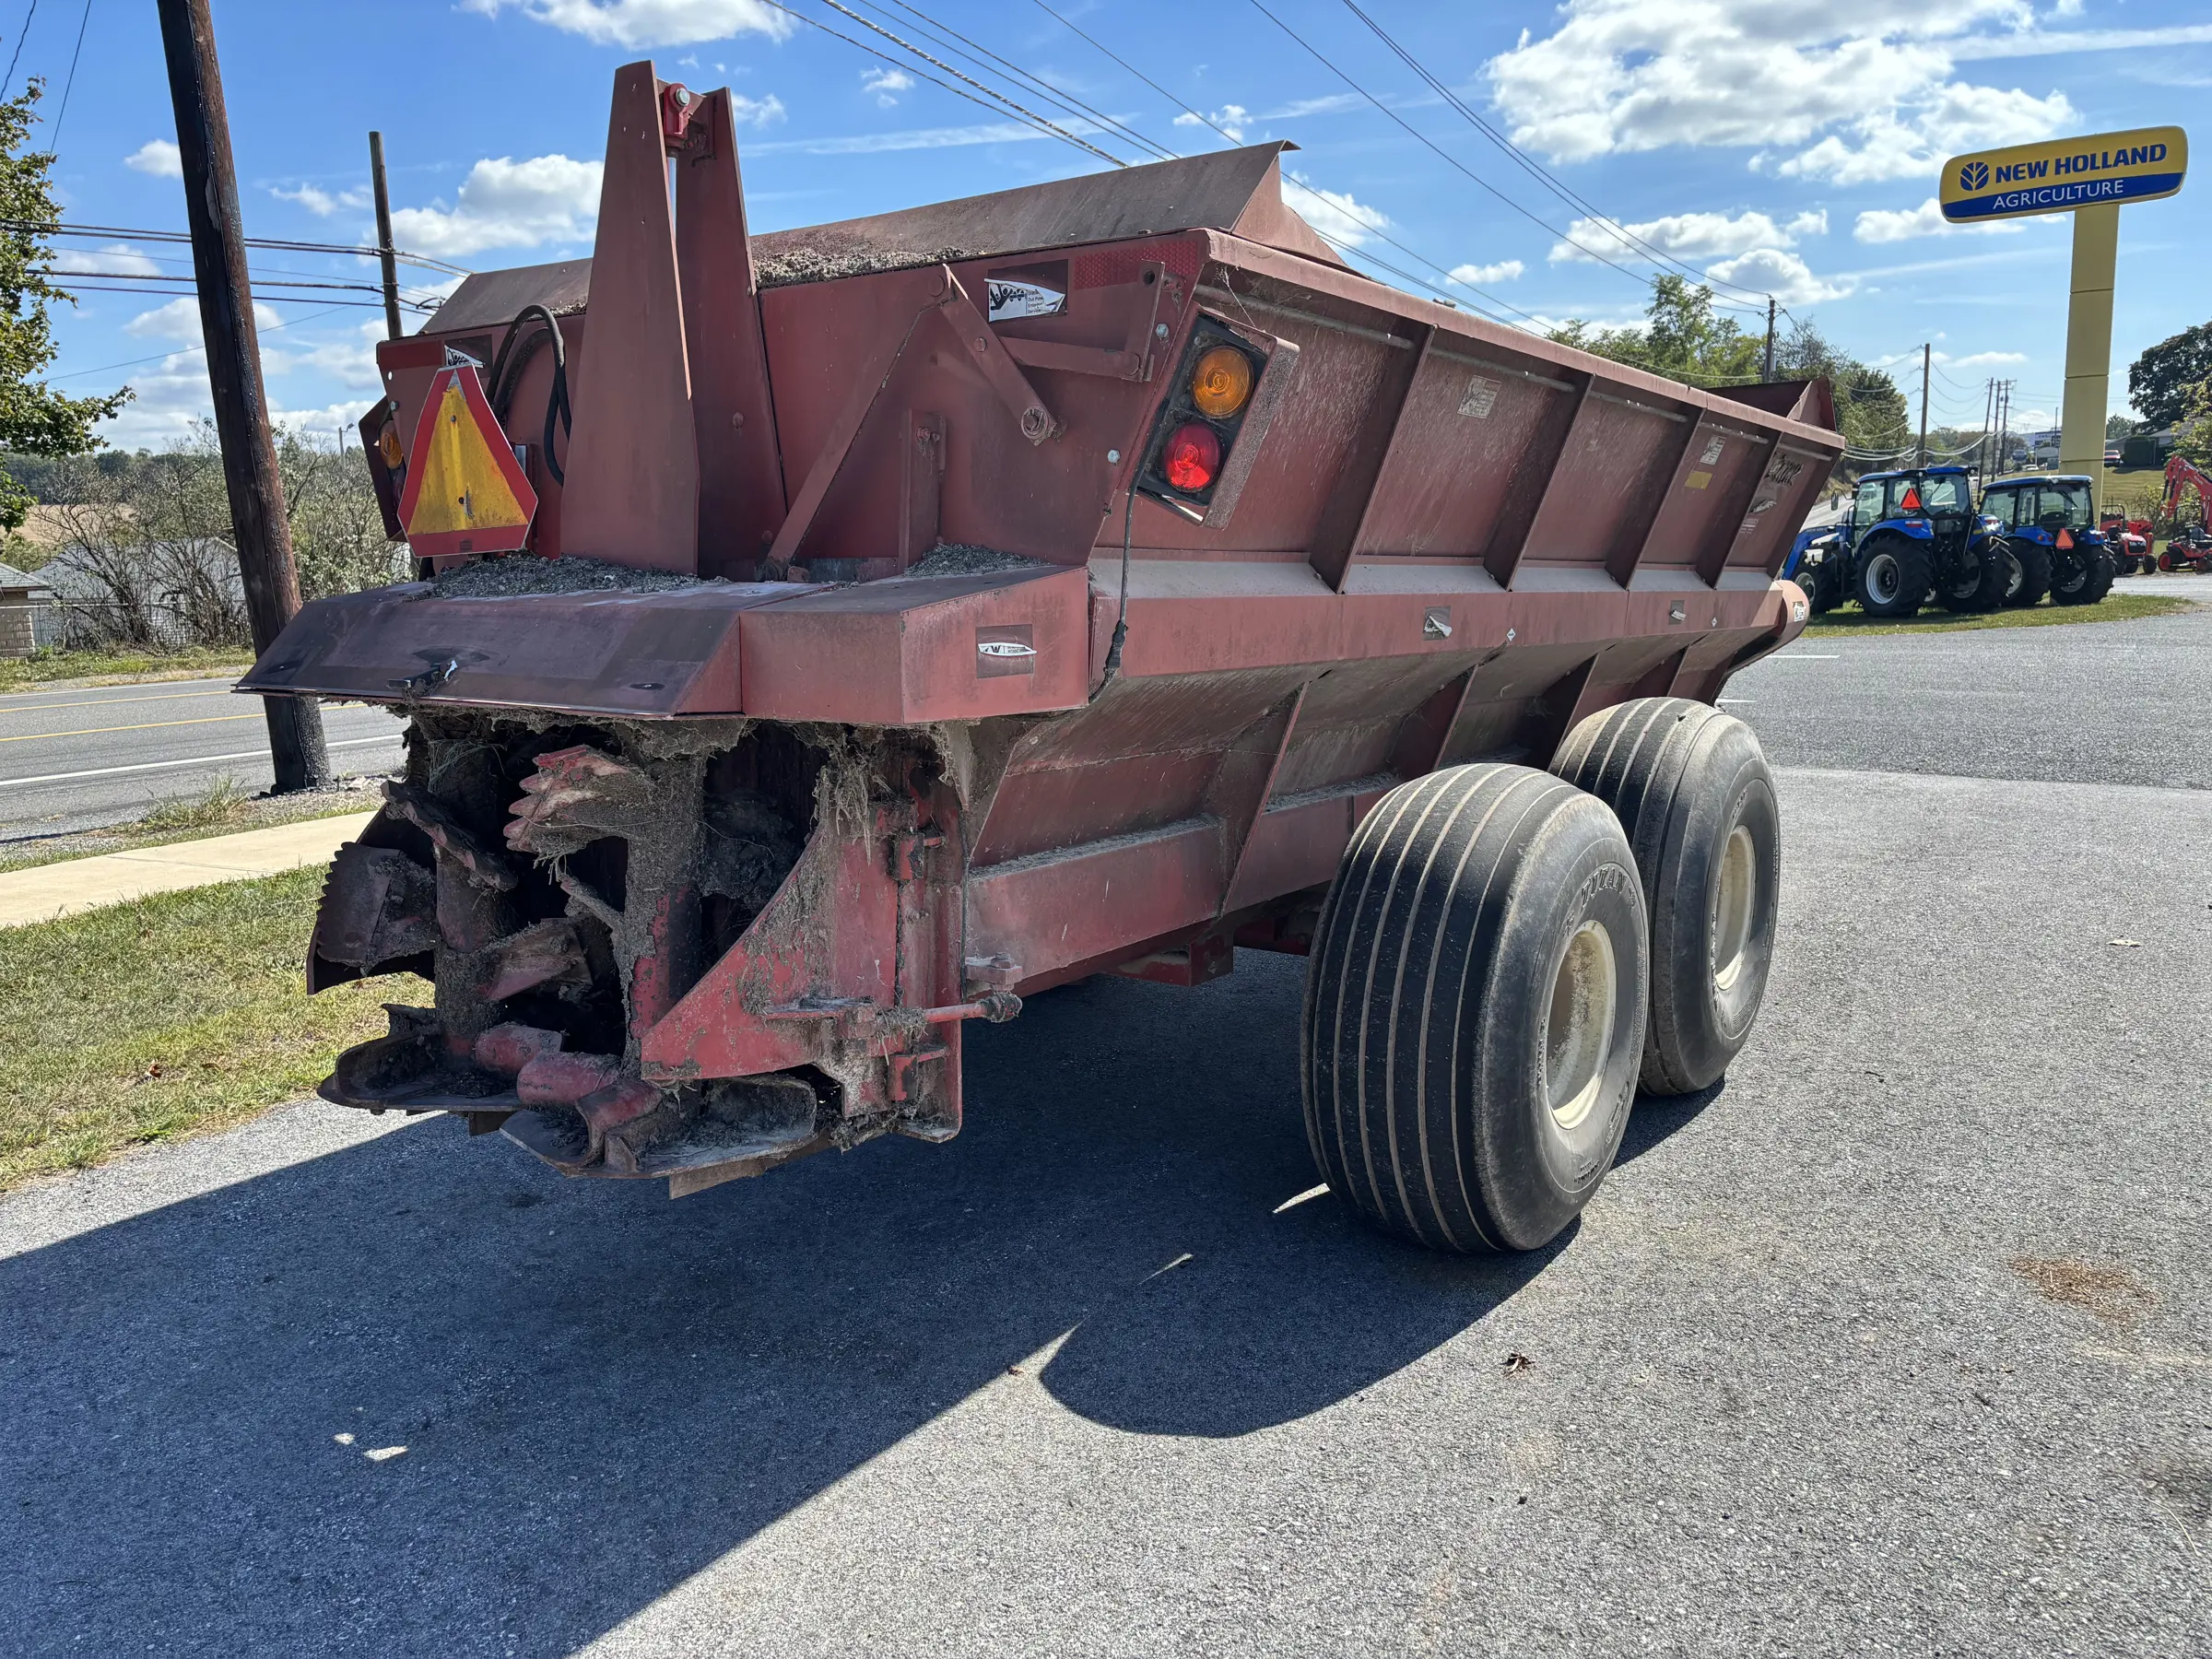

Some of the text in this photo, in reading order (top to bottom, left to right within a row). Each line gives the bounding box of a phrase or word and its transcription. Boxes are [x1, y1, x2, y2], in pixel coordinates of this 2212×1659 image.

[1995, 144, 2167, 183] NEW HOLLAND
[1993, 180, 2124, 210] AGRICULTURE
[1581, 865, 1628, 909] TITAN
